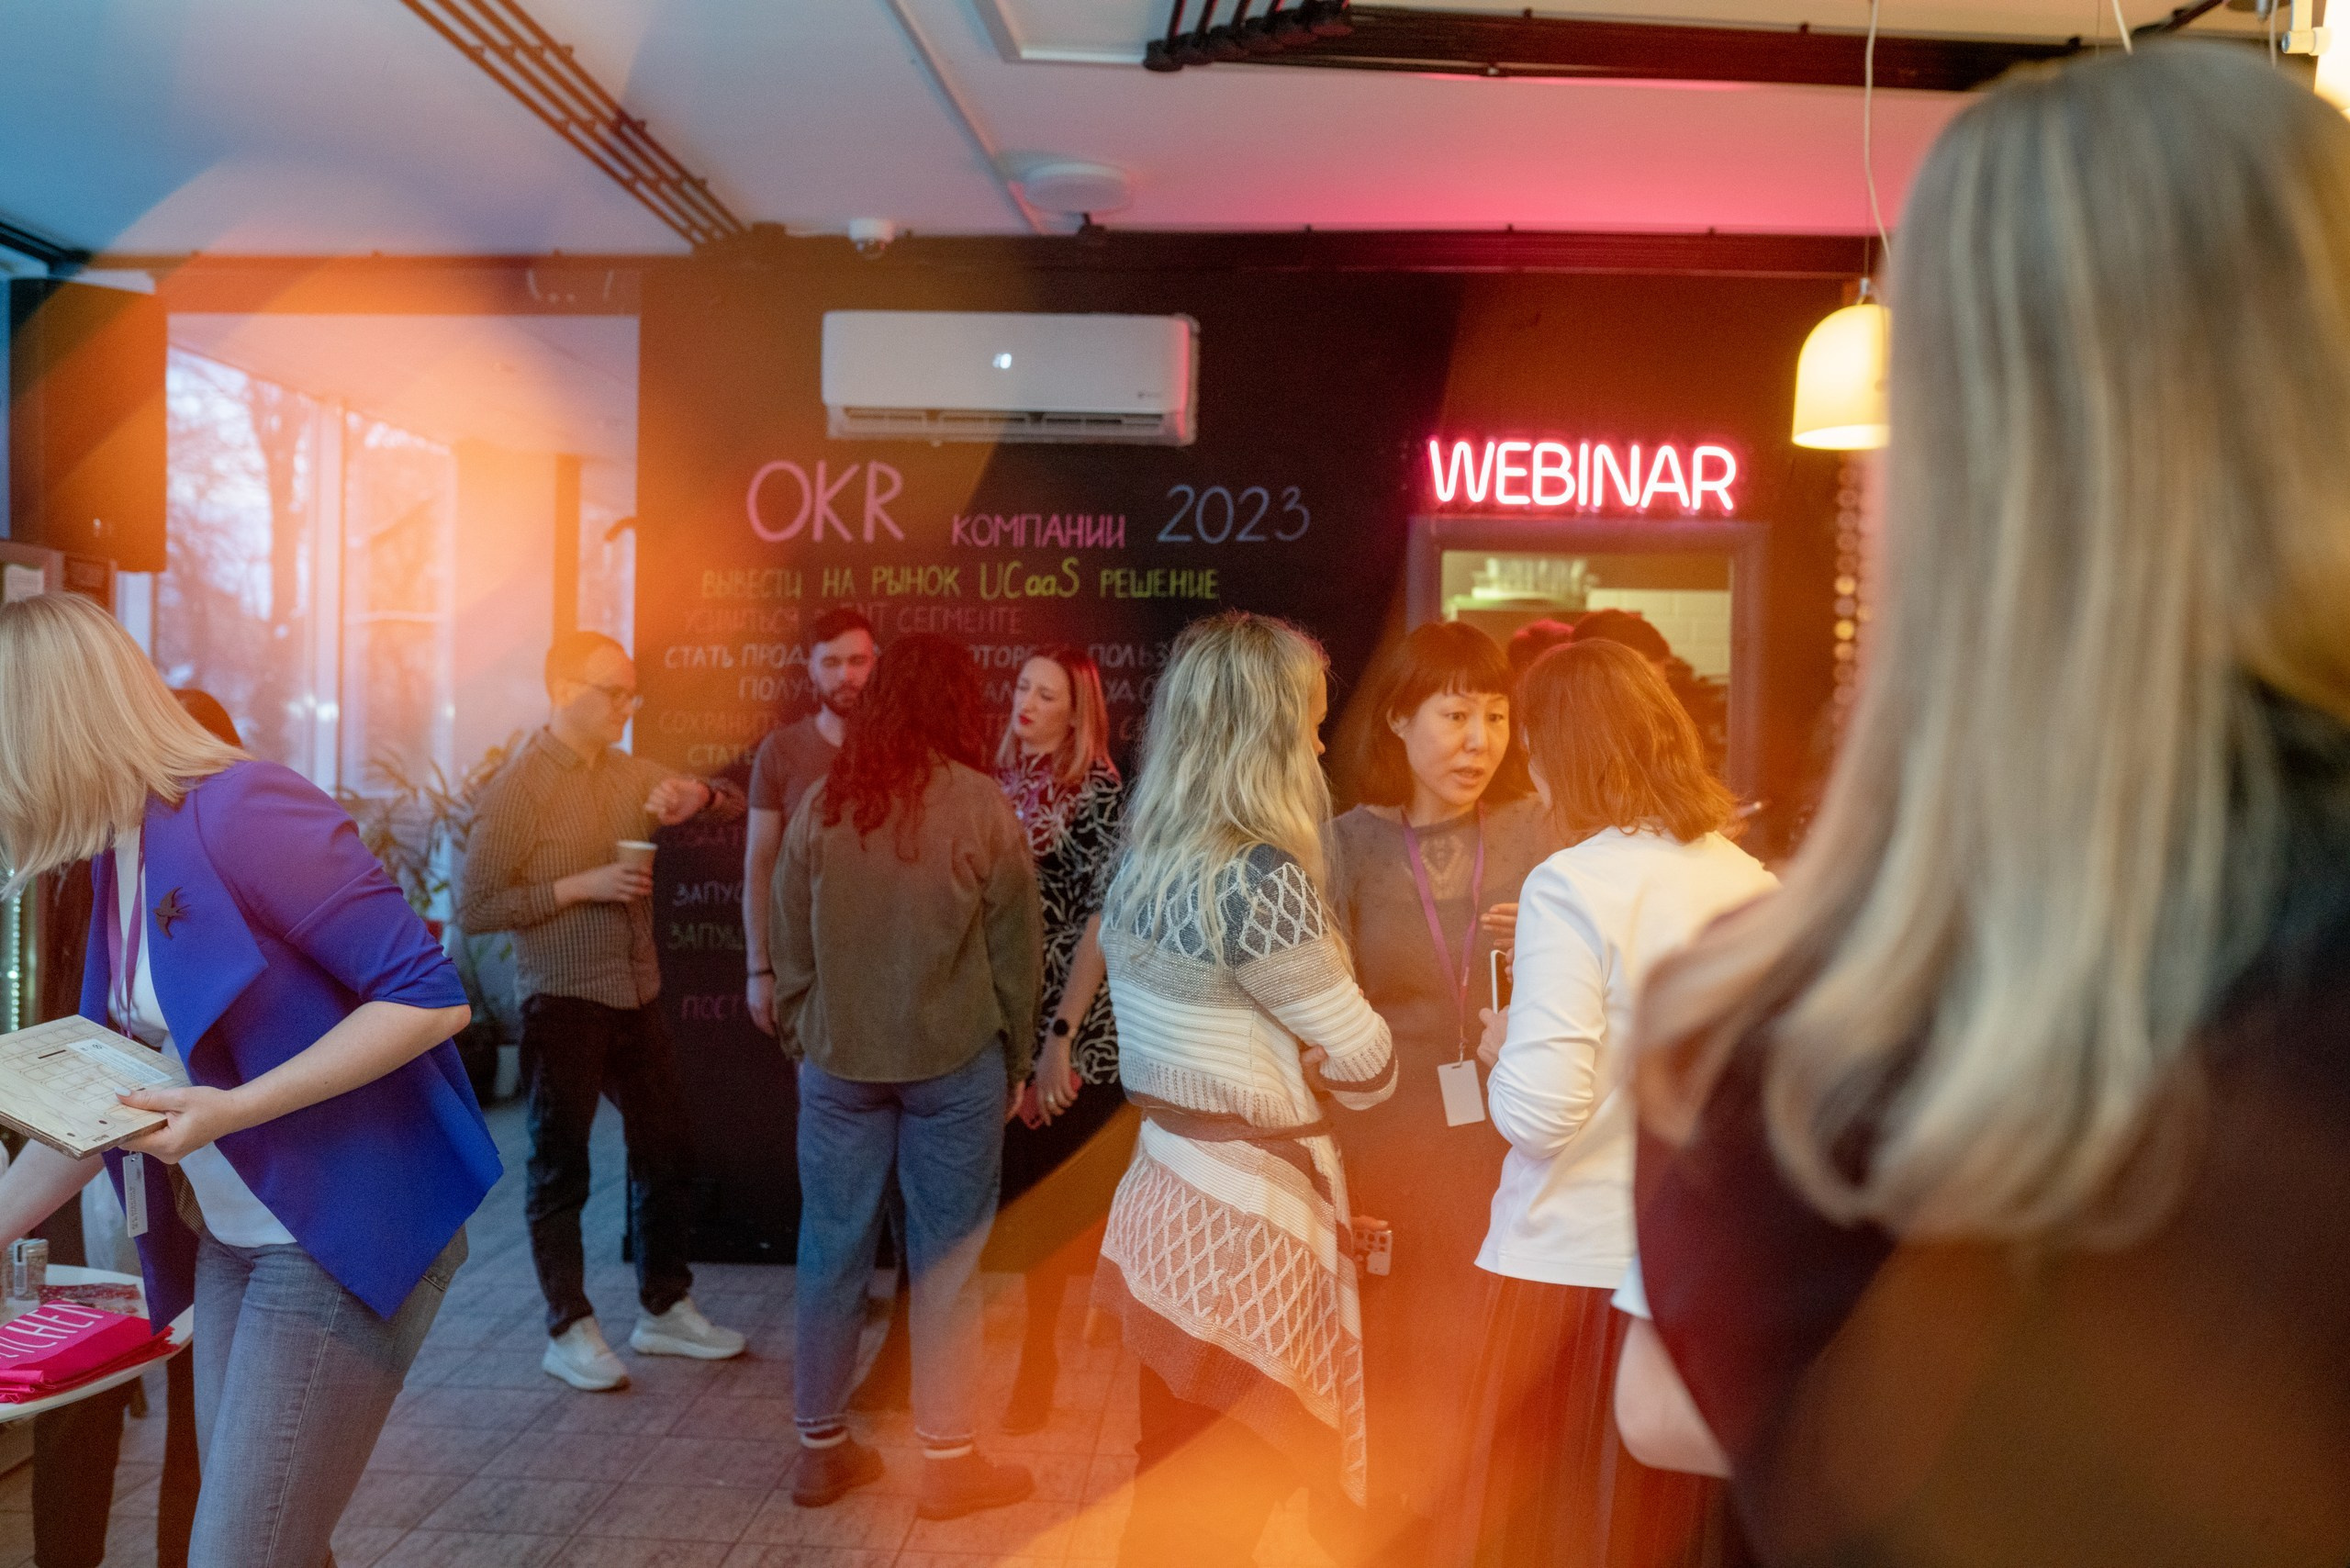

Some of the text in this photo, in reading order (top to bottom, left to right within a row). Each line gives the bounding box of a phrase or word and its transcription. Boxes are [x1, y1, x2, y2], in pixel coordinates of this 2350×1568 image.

[1427, 436, 1738, 515] WEBINAR
[746, 459, 1311, 549] OKR КОМПАНИИ 2023
[700, 556, 1220, 600] ВЫВЕСТИ НА РЫНОК UCaaS РЕШЕНИЕ
[896, 606, 1023, 634] СЕГМЕНТЕ
[664, 644, 734, 669] СТАТЬ
[741, 643, 810, 669] ПРОД
[1086, 642, 1169, 669] ПОЛЬЗ
